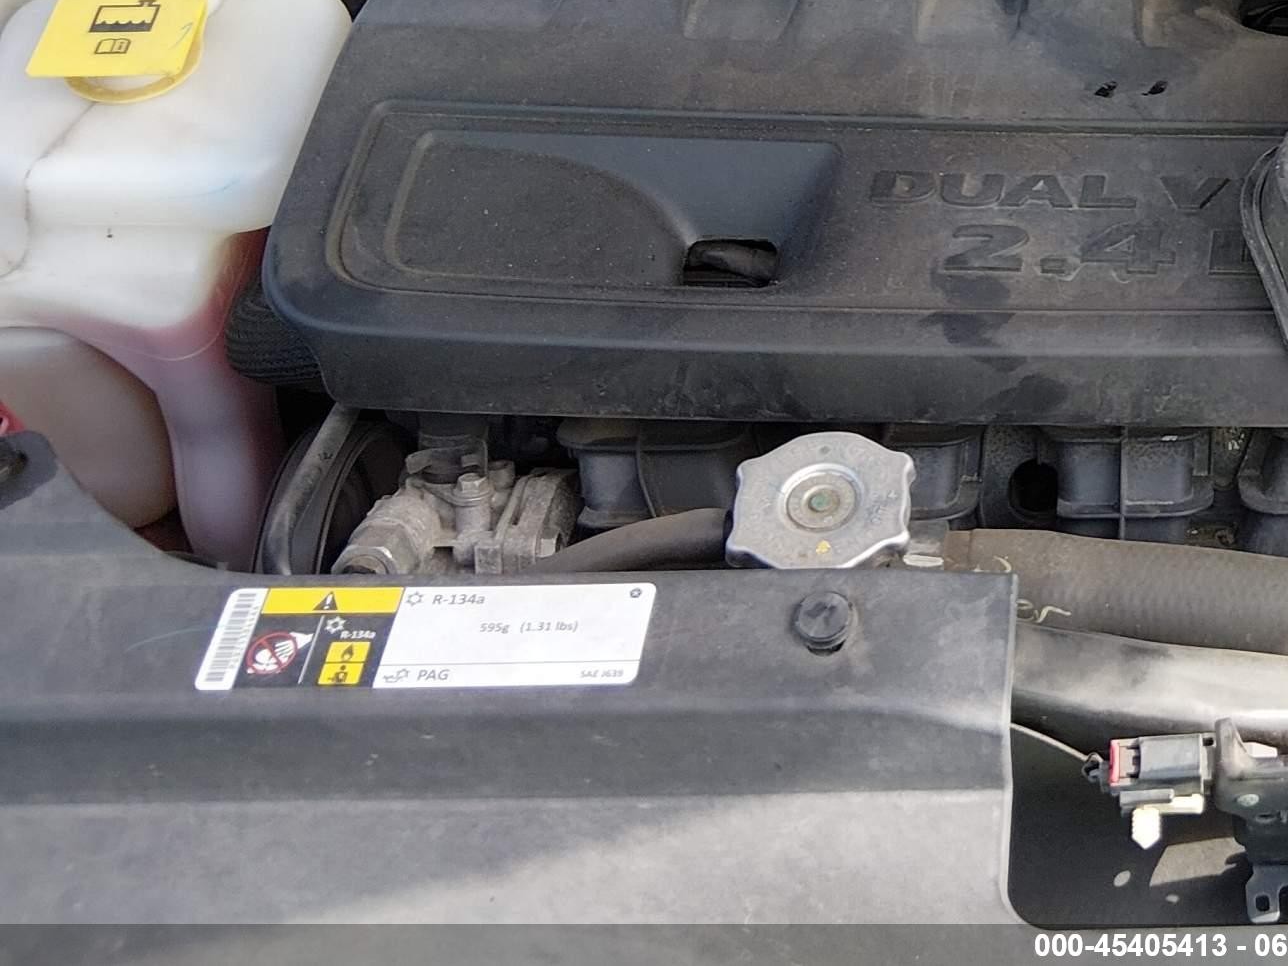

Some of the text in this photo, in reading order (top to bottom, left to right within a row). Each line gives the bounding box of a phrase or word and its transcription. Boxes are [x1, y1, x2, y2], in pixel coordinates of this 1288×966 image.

[868, 170, 1137, 209] DUAL
[432, 593, 485, 605] R-134a
[480, 620, 579, 634] 595g (1.31 lbs)
[339, 629, 376, 639] R-134a
[417, 669, 449, 681] PAG
